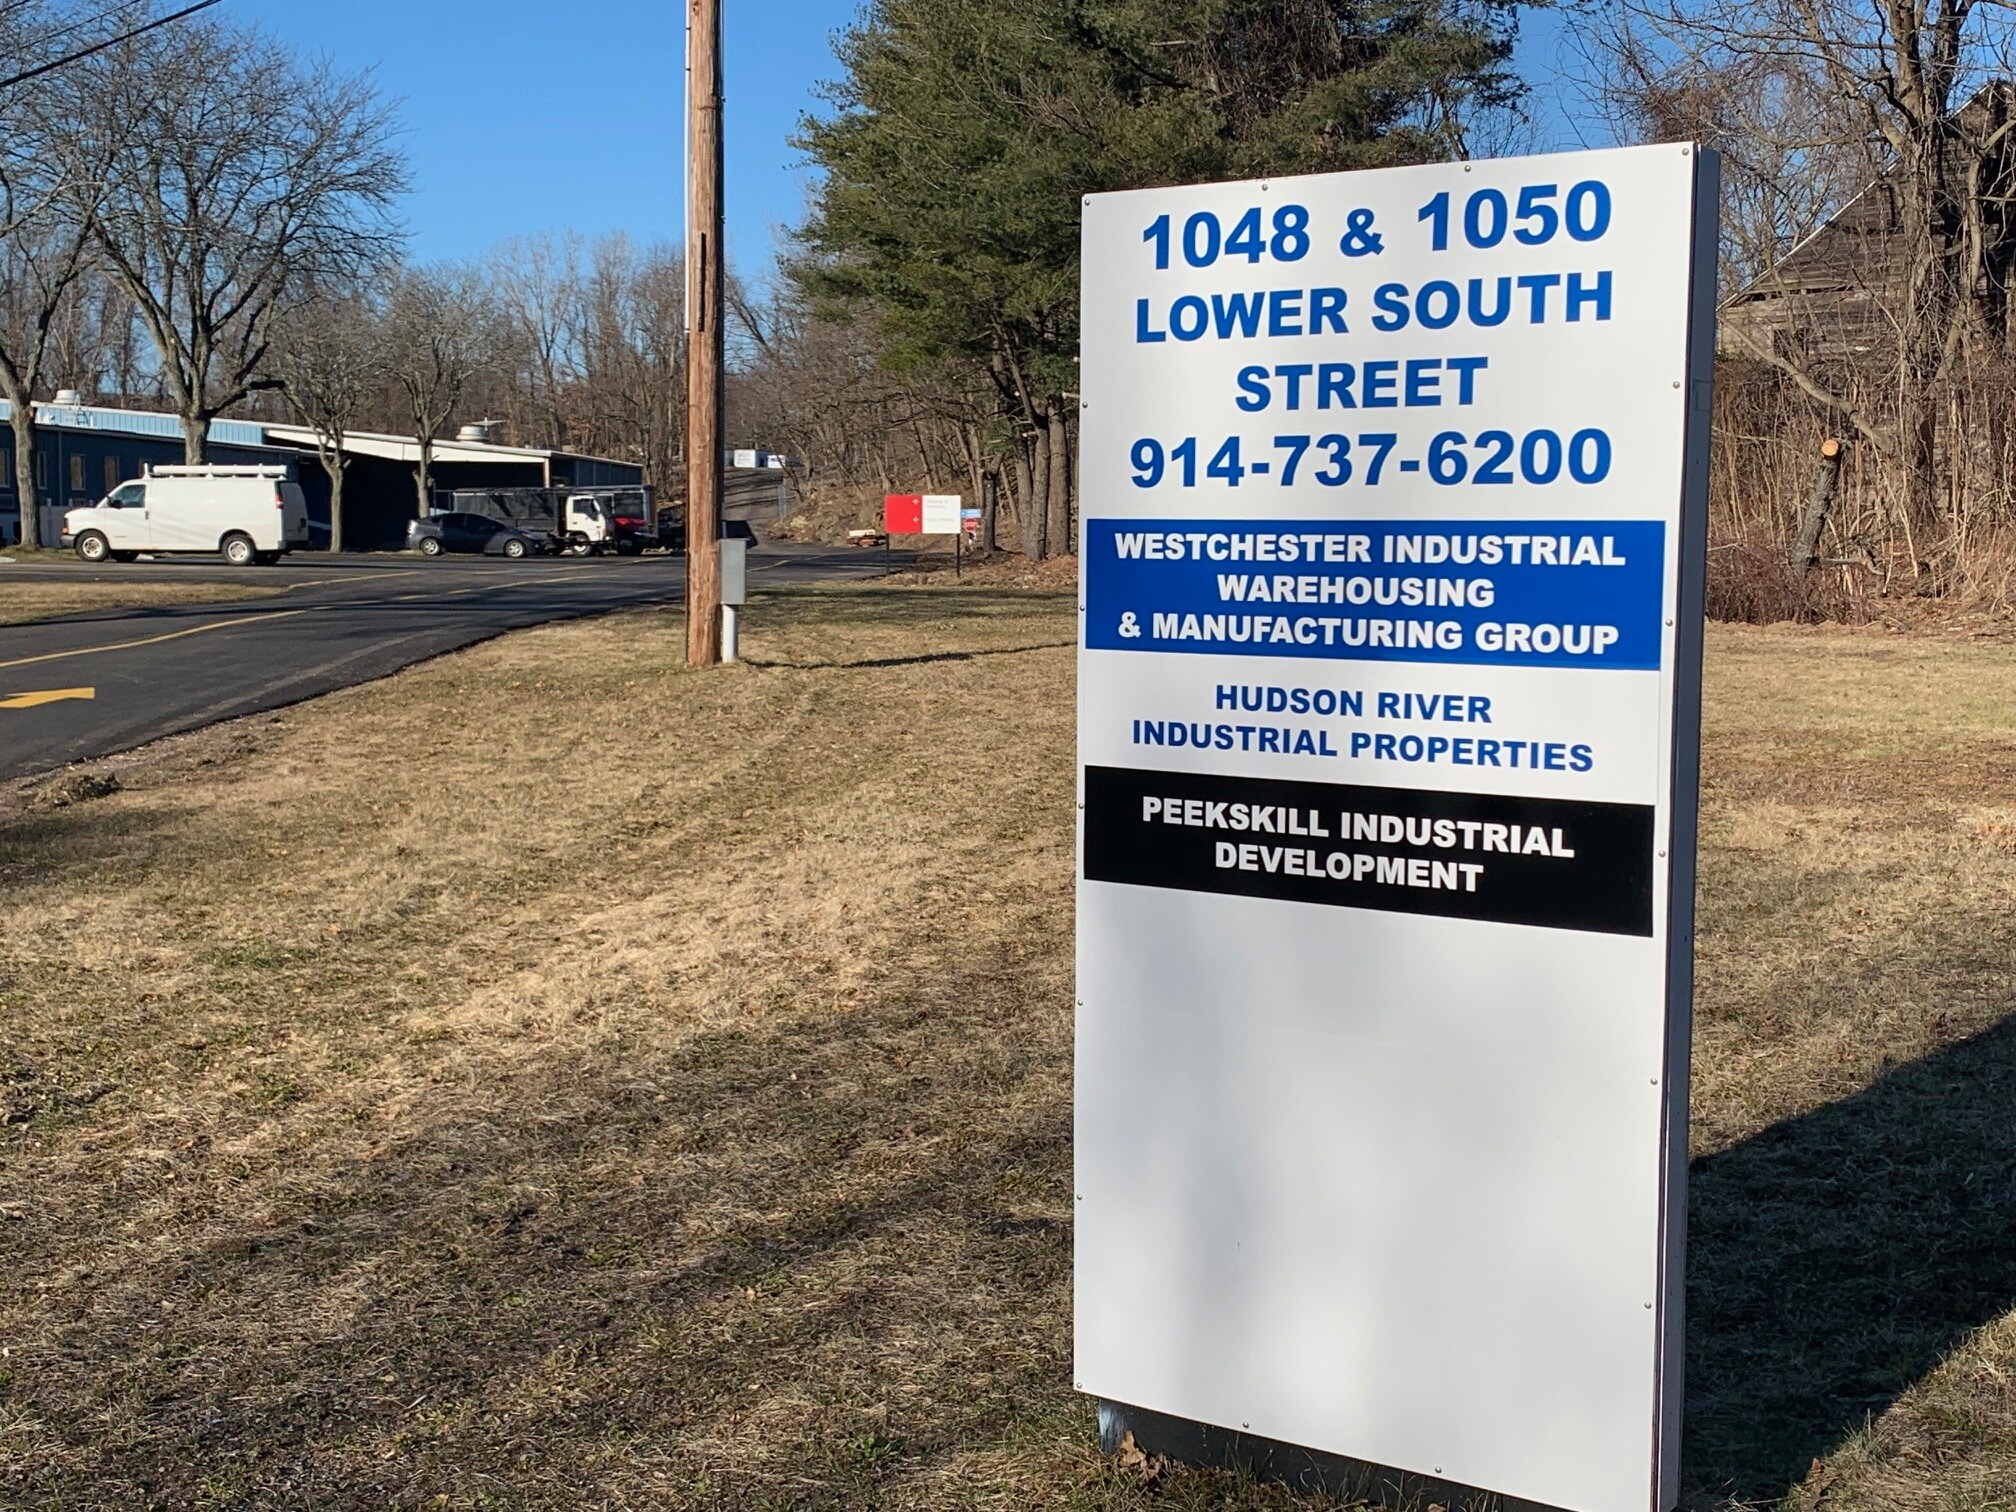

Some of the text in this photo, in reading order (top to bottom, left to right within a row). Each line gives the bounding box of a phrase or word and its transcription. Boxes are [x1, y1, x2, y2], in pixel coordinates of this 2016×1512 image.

[1143, 180, 1612, 270] 1048 & 1050
[1136, 270, 1612, 343] LOWER SOUTH
[1236, 356, 1488, 412] STREET
[1130, 428, 1612, 489] 914-737-6200
[1115, 533, 1626, 566] WESTCHESTER INDUSTRIAL
[1217, 574, 1495, 608] WAREHOUSING
[1118, 611, 1620, 655] & MANUFACTURING GROUP
[1215, 684, 1492, 723] HUDSON RIVER
[1132, 720, 1594, 772] INDUSTRIAL PROPERTIES
[1142, 796, 1575, 858] PEEKSKILL INDUSTRIAL
[1215, 841, 1484, 893] DEVELOPMENT
